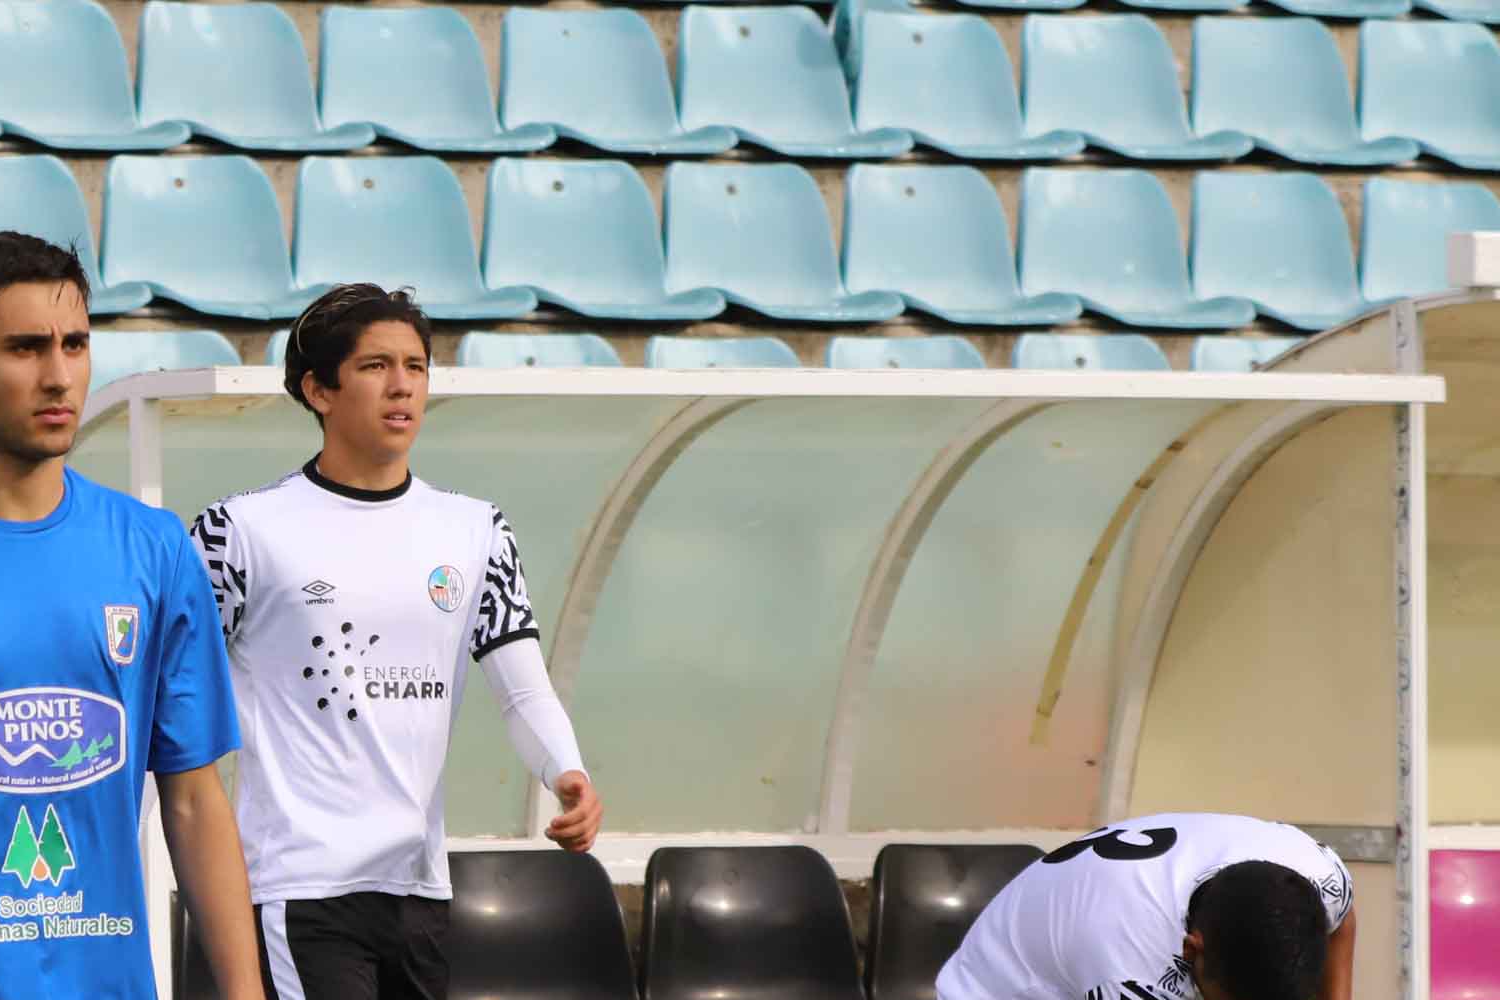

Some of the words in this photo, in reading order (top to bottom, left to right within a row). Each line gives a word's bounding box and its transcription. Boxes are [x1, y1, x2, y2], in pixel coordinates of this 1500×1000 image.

[365, 681, 450, 700] CHARR
[4, 719, 85, 743] PINOS
[43, 913, 133, 939] Naturales
